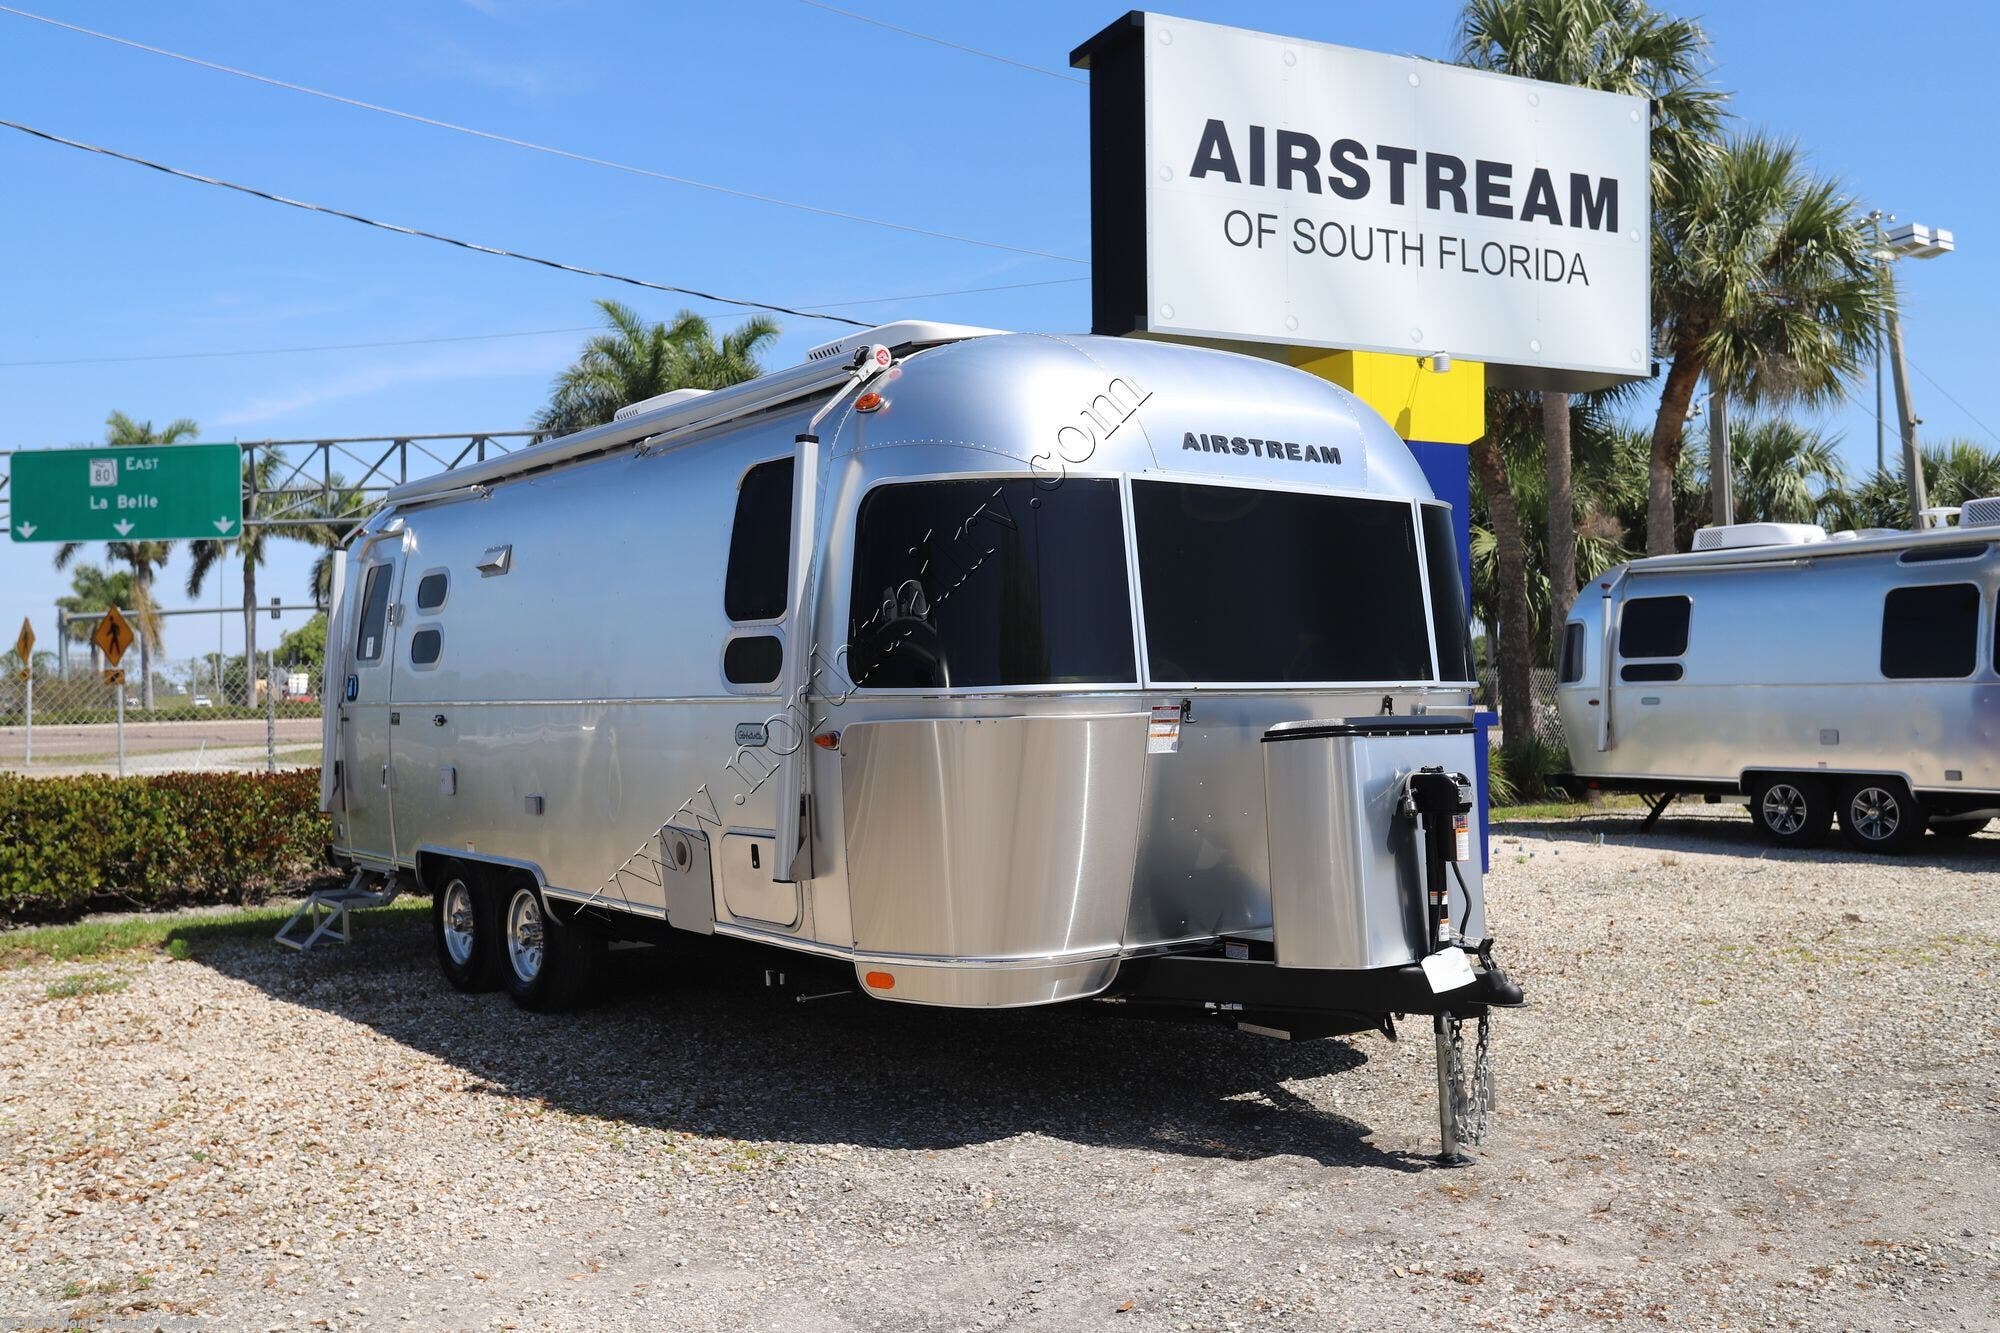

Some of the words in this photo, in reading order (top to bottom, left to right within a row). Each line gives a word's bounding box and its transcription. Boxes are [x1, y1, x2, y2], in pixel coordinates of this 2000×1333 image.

[1189, 118, 1619, 233] AIRSTREAM
[1224, 209, 1279, 249] OF
[1292, 217, 1425, 268] SOUTH
[1438, 235, 1590, 287] FLORIDA
[1182, 431, 1342, 466] AIRSTREAM
[96, 469, 110, 482] 80
[126, 457, 159, 470] EAST
[91, 496, 108, 510] La
[118, 495, 158, 509] Belle
